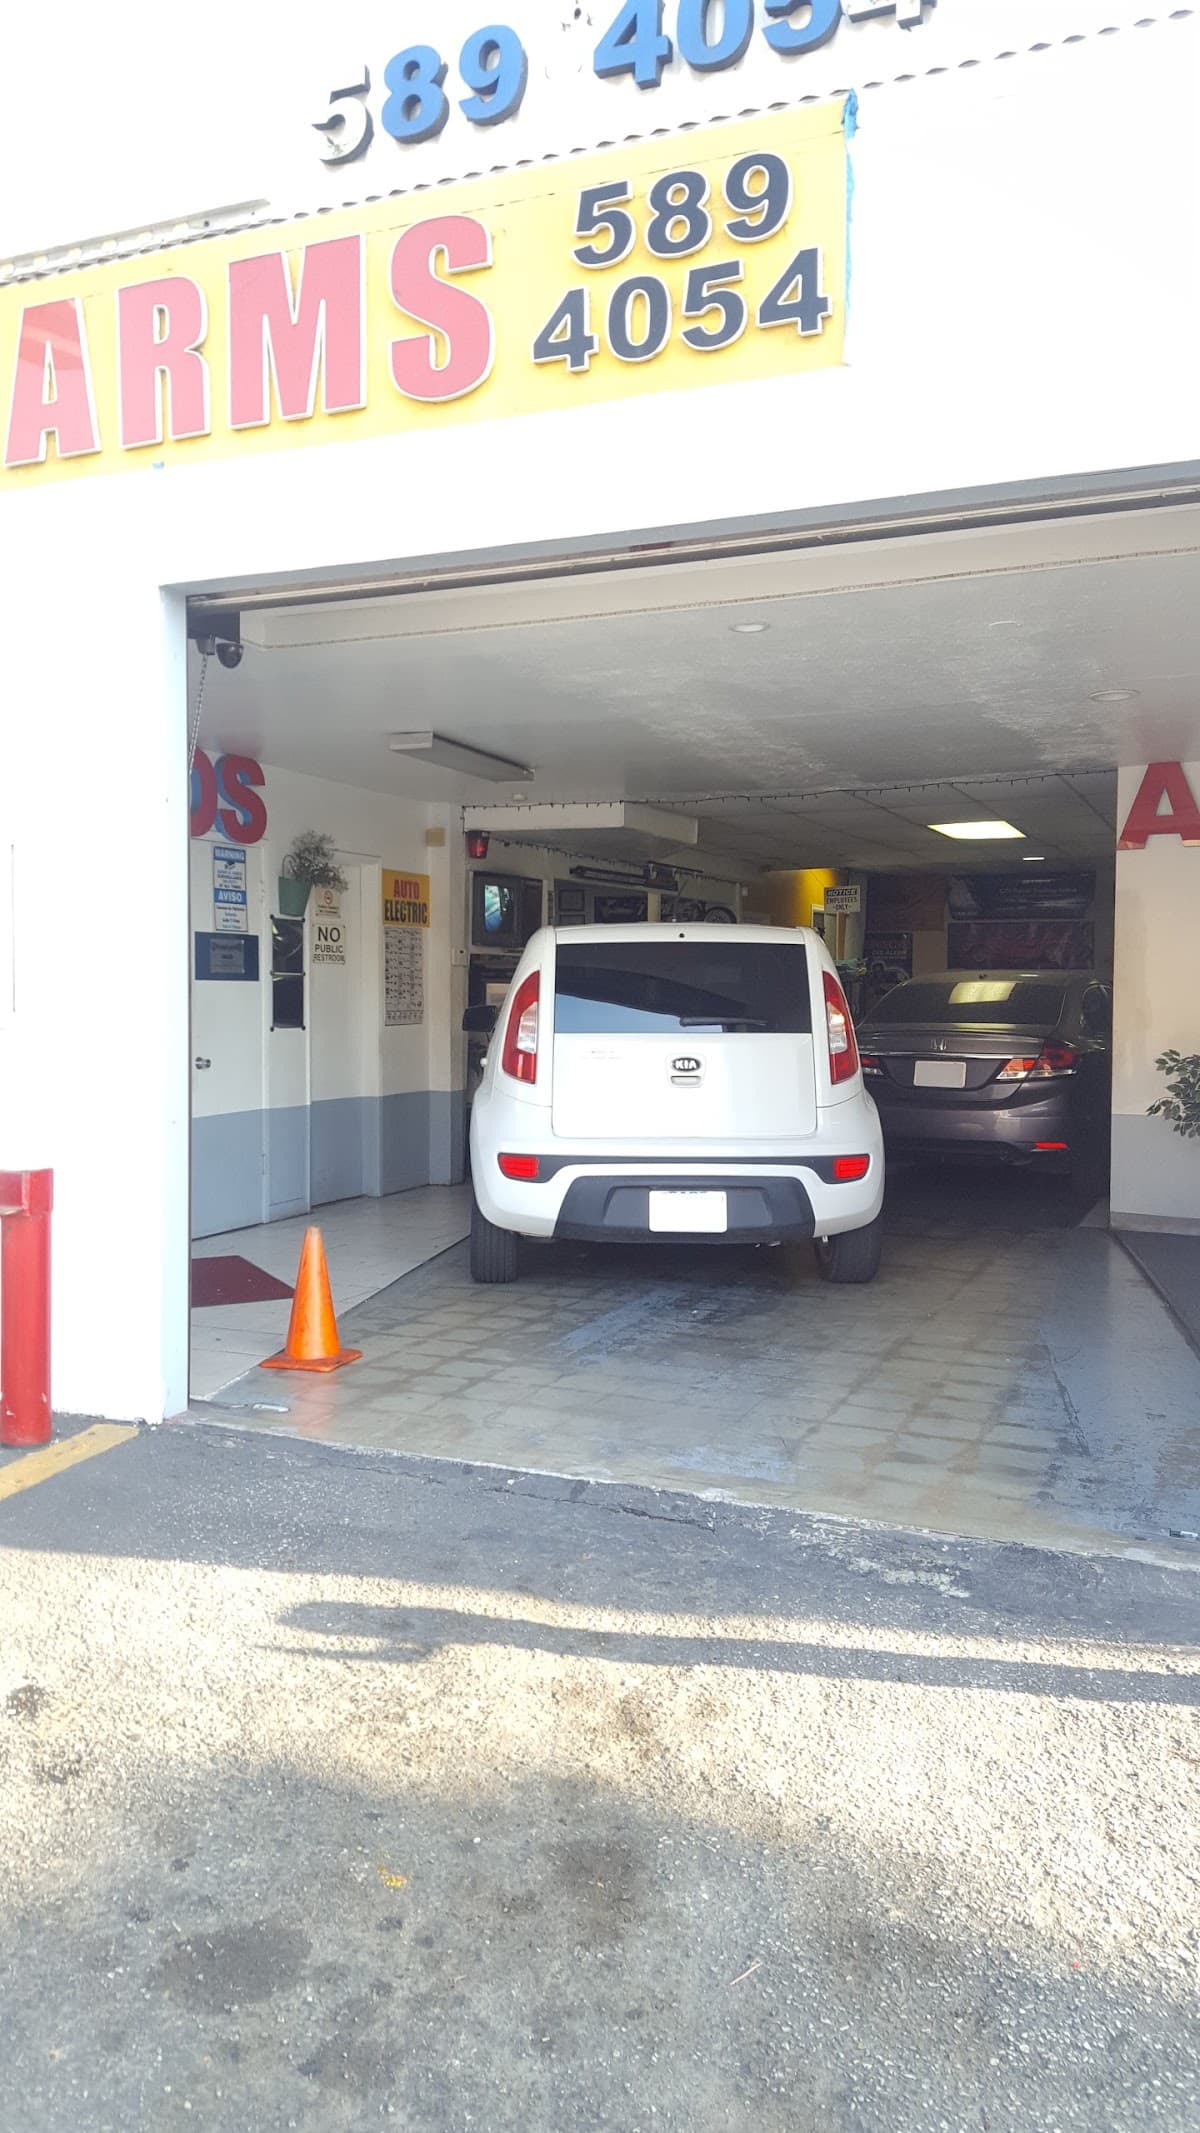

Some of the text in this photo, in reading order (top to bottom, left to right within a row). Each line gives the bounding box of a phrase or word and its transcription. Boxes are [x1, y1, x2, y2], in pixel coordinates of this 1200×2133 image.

[312, 24, 529, 166] 589
[571, 150, 794, 270] 589
[531, 246, 833, 374] 4054
[2, 214, 497, 469] ARMS
[218, 889, 243, 902] AVISO
[393, 879, 420, 900] AUTO
[827, 888, 857, 896] NOTICE
[384, 899, 428, 924] ELECTRIC
[318, 926, 341, 943] NO
[314, 943, 344, 954] PUBLIC
